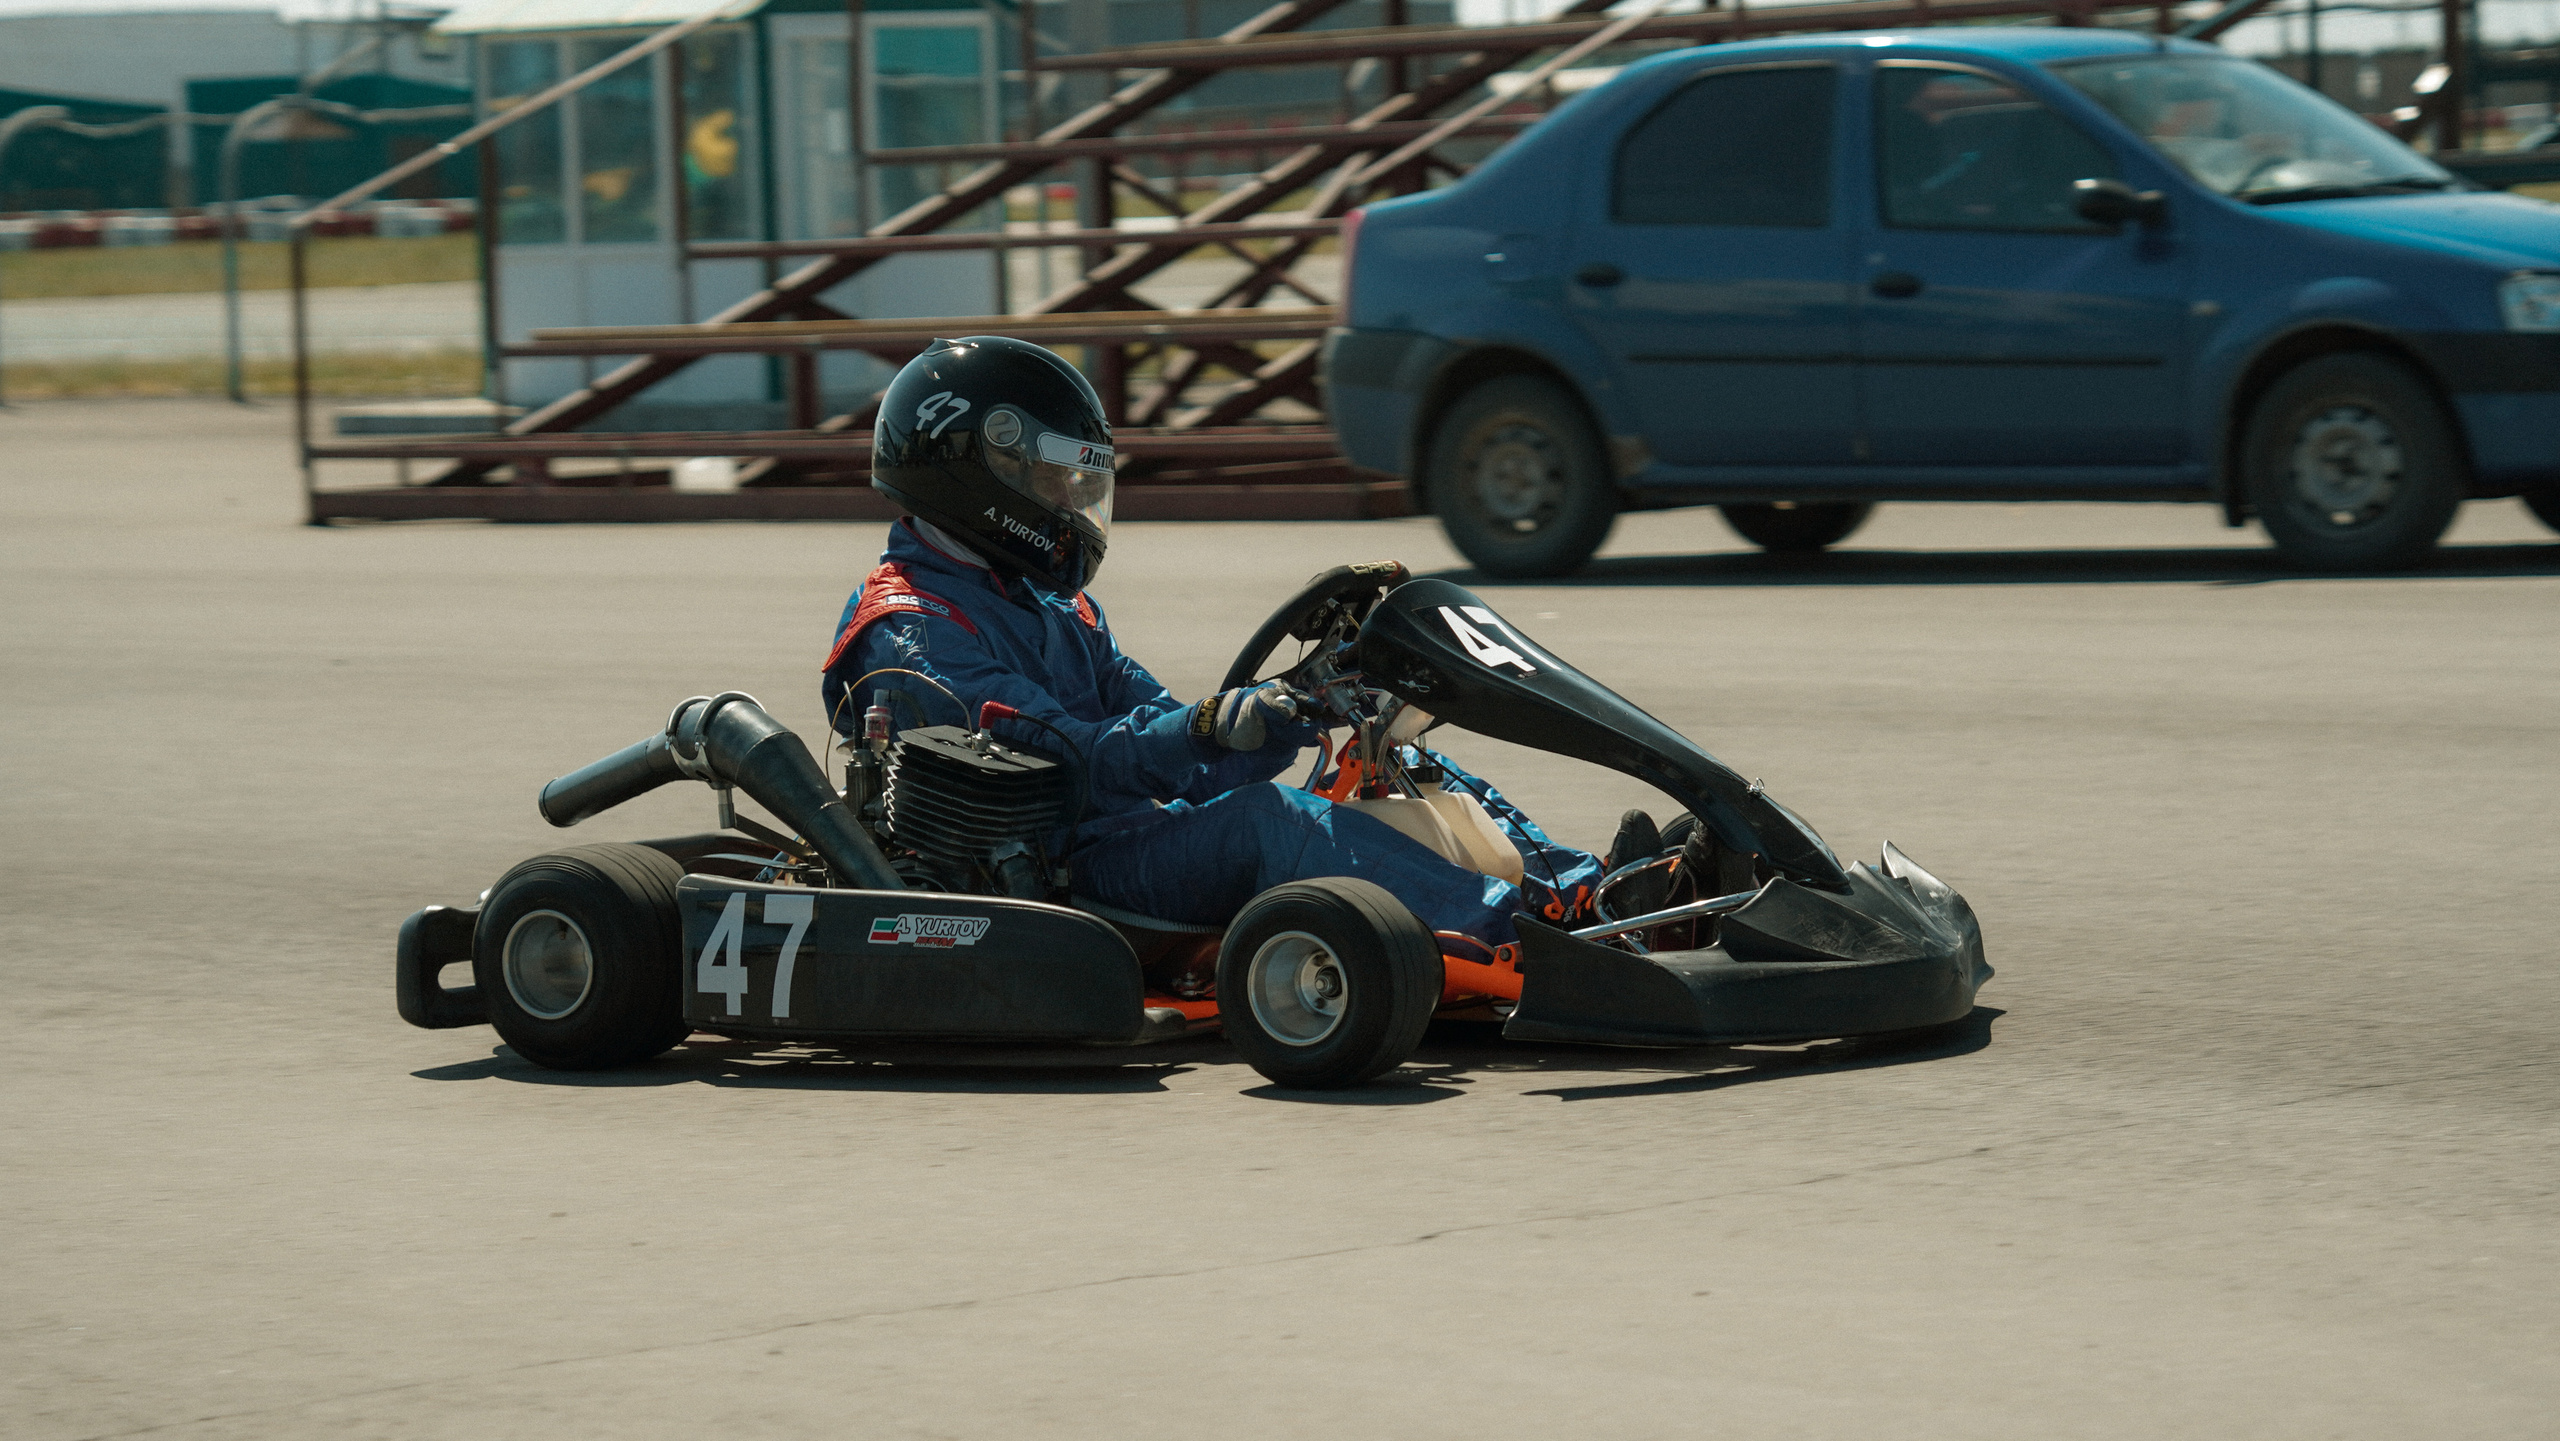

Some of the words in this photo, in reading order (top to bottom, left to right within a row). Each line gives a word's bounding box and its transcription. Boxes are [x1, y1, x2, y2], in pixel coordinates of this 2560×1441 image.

[916, 391, 971, 439] 47
[984, 506, 997, 522] A.
[1001, 514, 1055, 552] YURTOV
[1437, 605, 1563, 672] 47
[1198, 698, 1217, 733] OMP
[892, 916, 911, 934] A.
[915, 916, 988, 938] YURTOV
[696, 891, 815, 1019] 47
